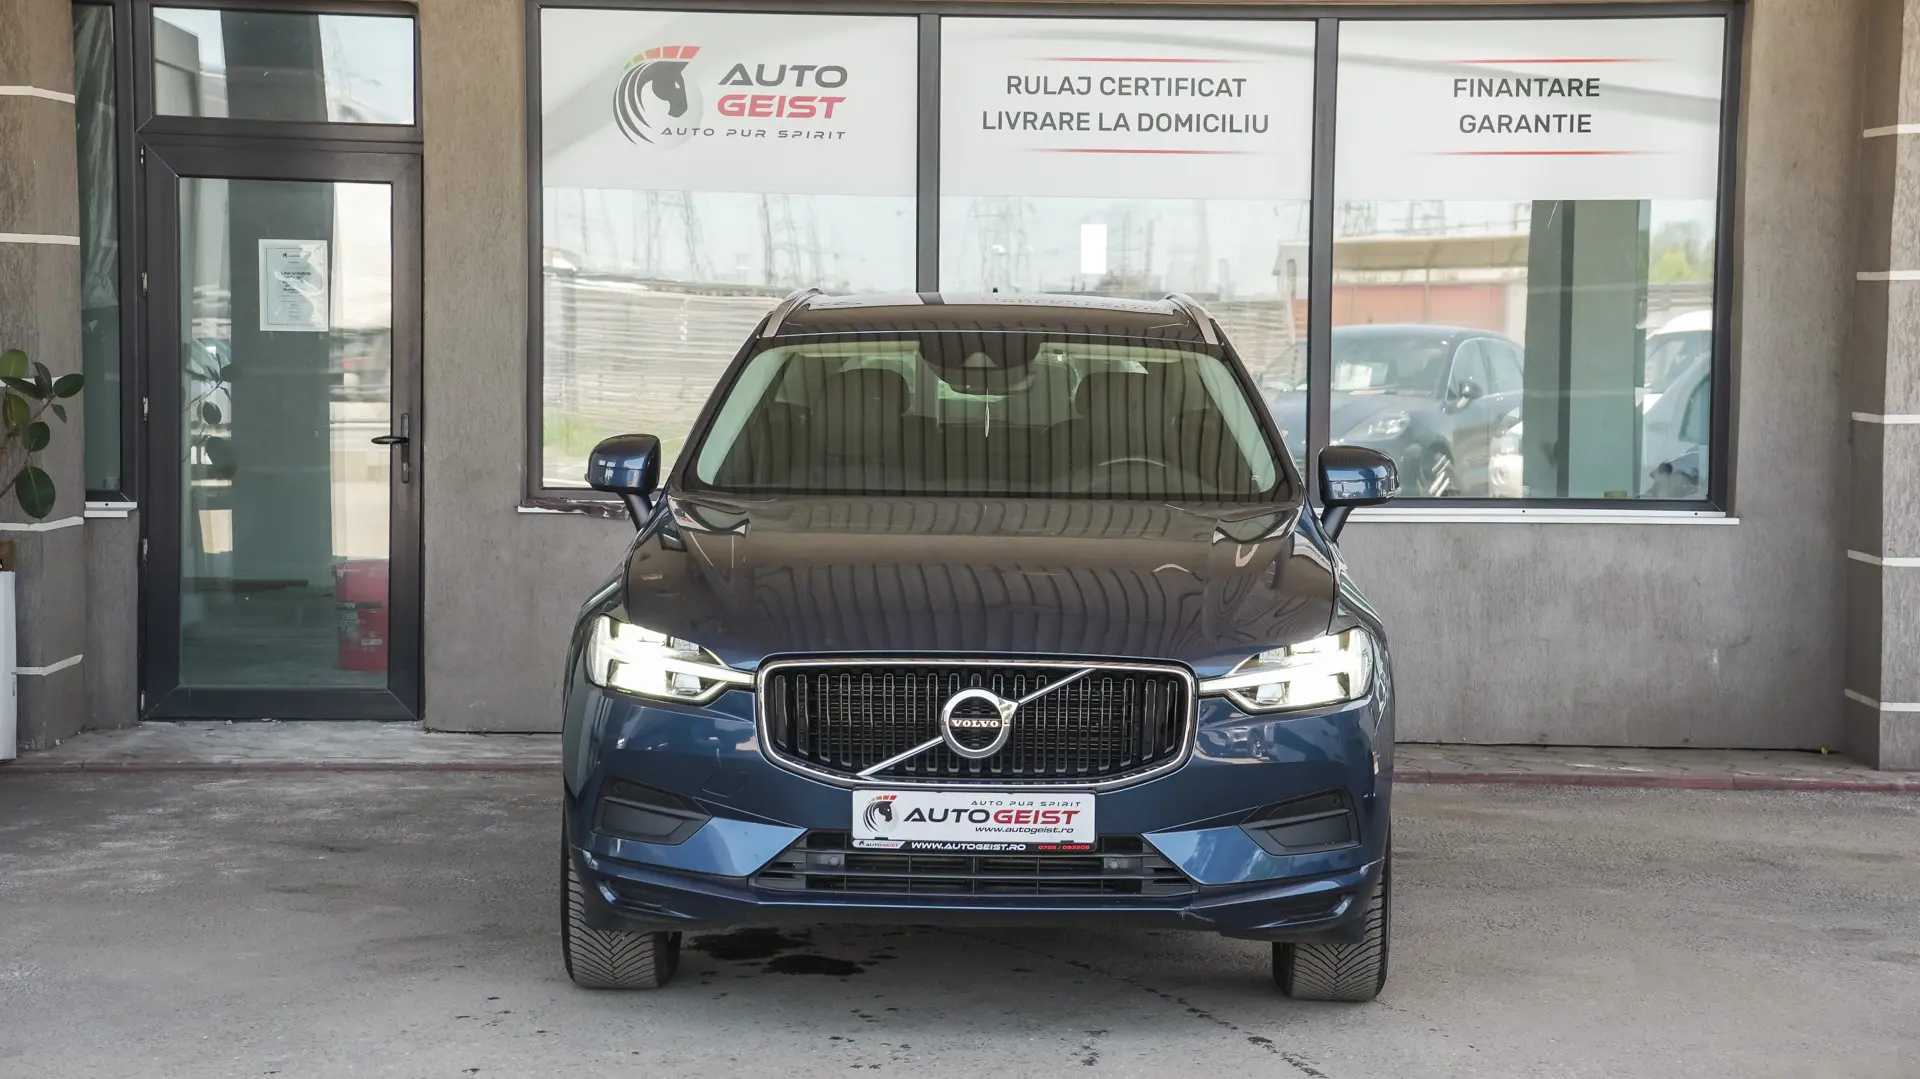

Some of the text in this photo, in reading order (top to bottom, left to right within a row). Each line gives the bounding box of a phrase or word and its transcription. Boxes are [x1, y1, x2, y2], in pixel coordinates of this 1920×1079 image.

[718, 63, 848, 88] AUTO
[1007, 75, 1247, 97] RULAJ CERTIFICAT
[1453, 77, 1600, 98] FINANTARE
[717, 93, 847, 119] GEIST
[982, 110, 1269, 133] LIVRARE LA DOMICILIU
[1459, 114, 1592, 134] GARANTIE
[661, 127, 847, 140] AUTO PUR SPIRIT
[951, 719, 999, 728] VOLVO
[975, 826, 1074, 835] www.autogeist.ro
[911, 842, 1026, 851] WWW.AUTOGEIST.RO
